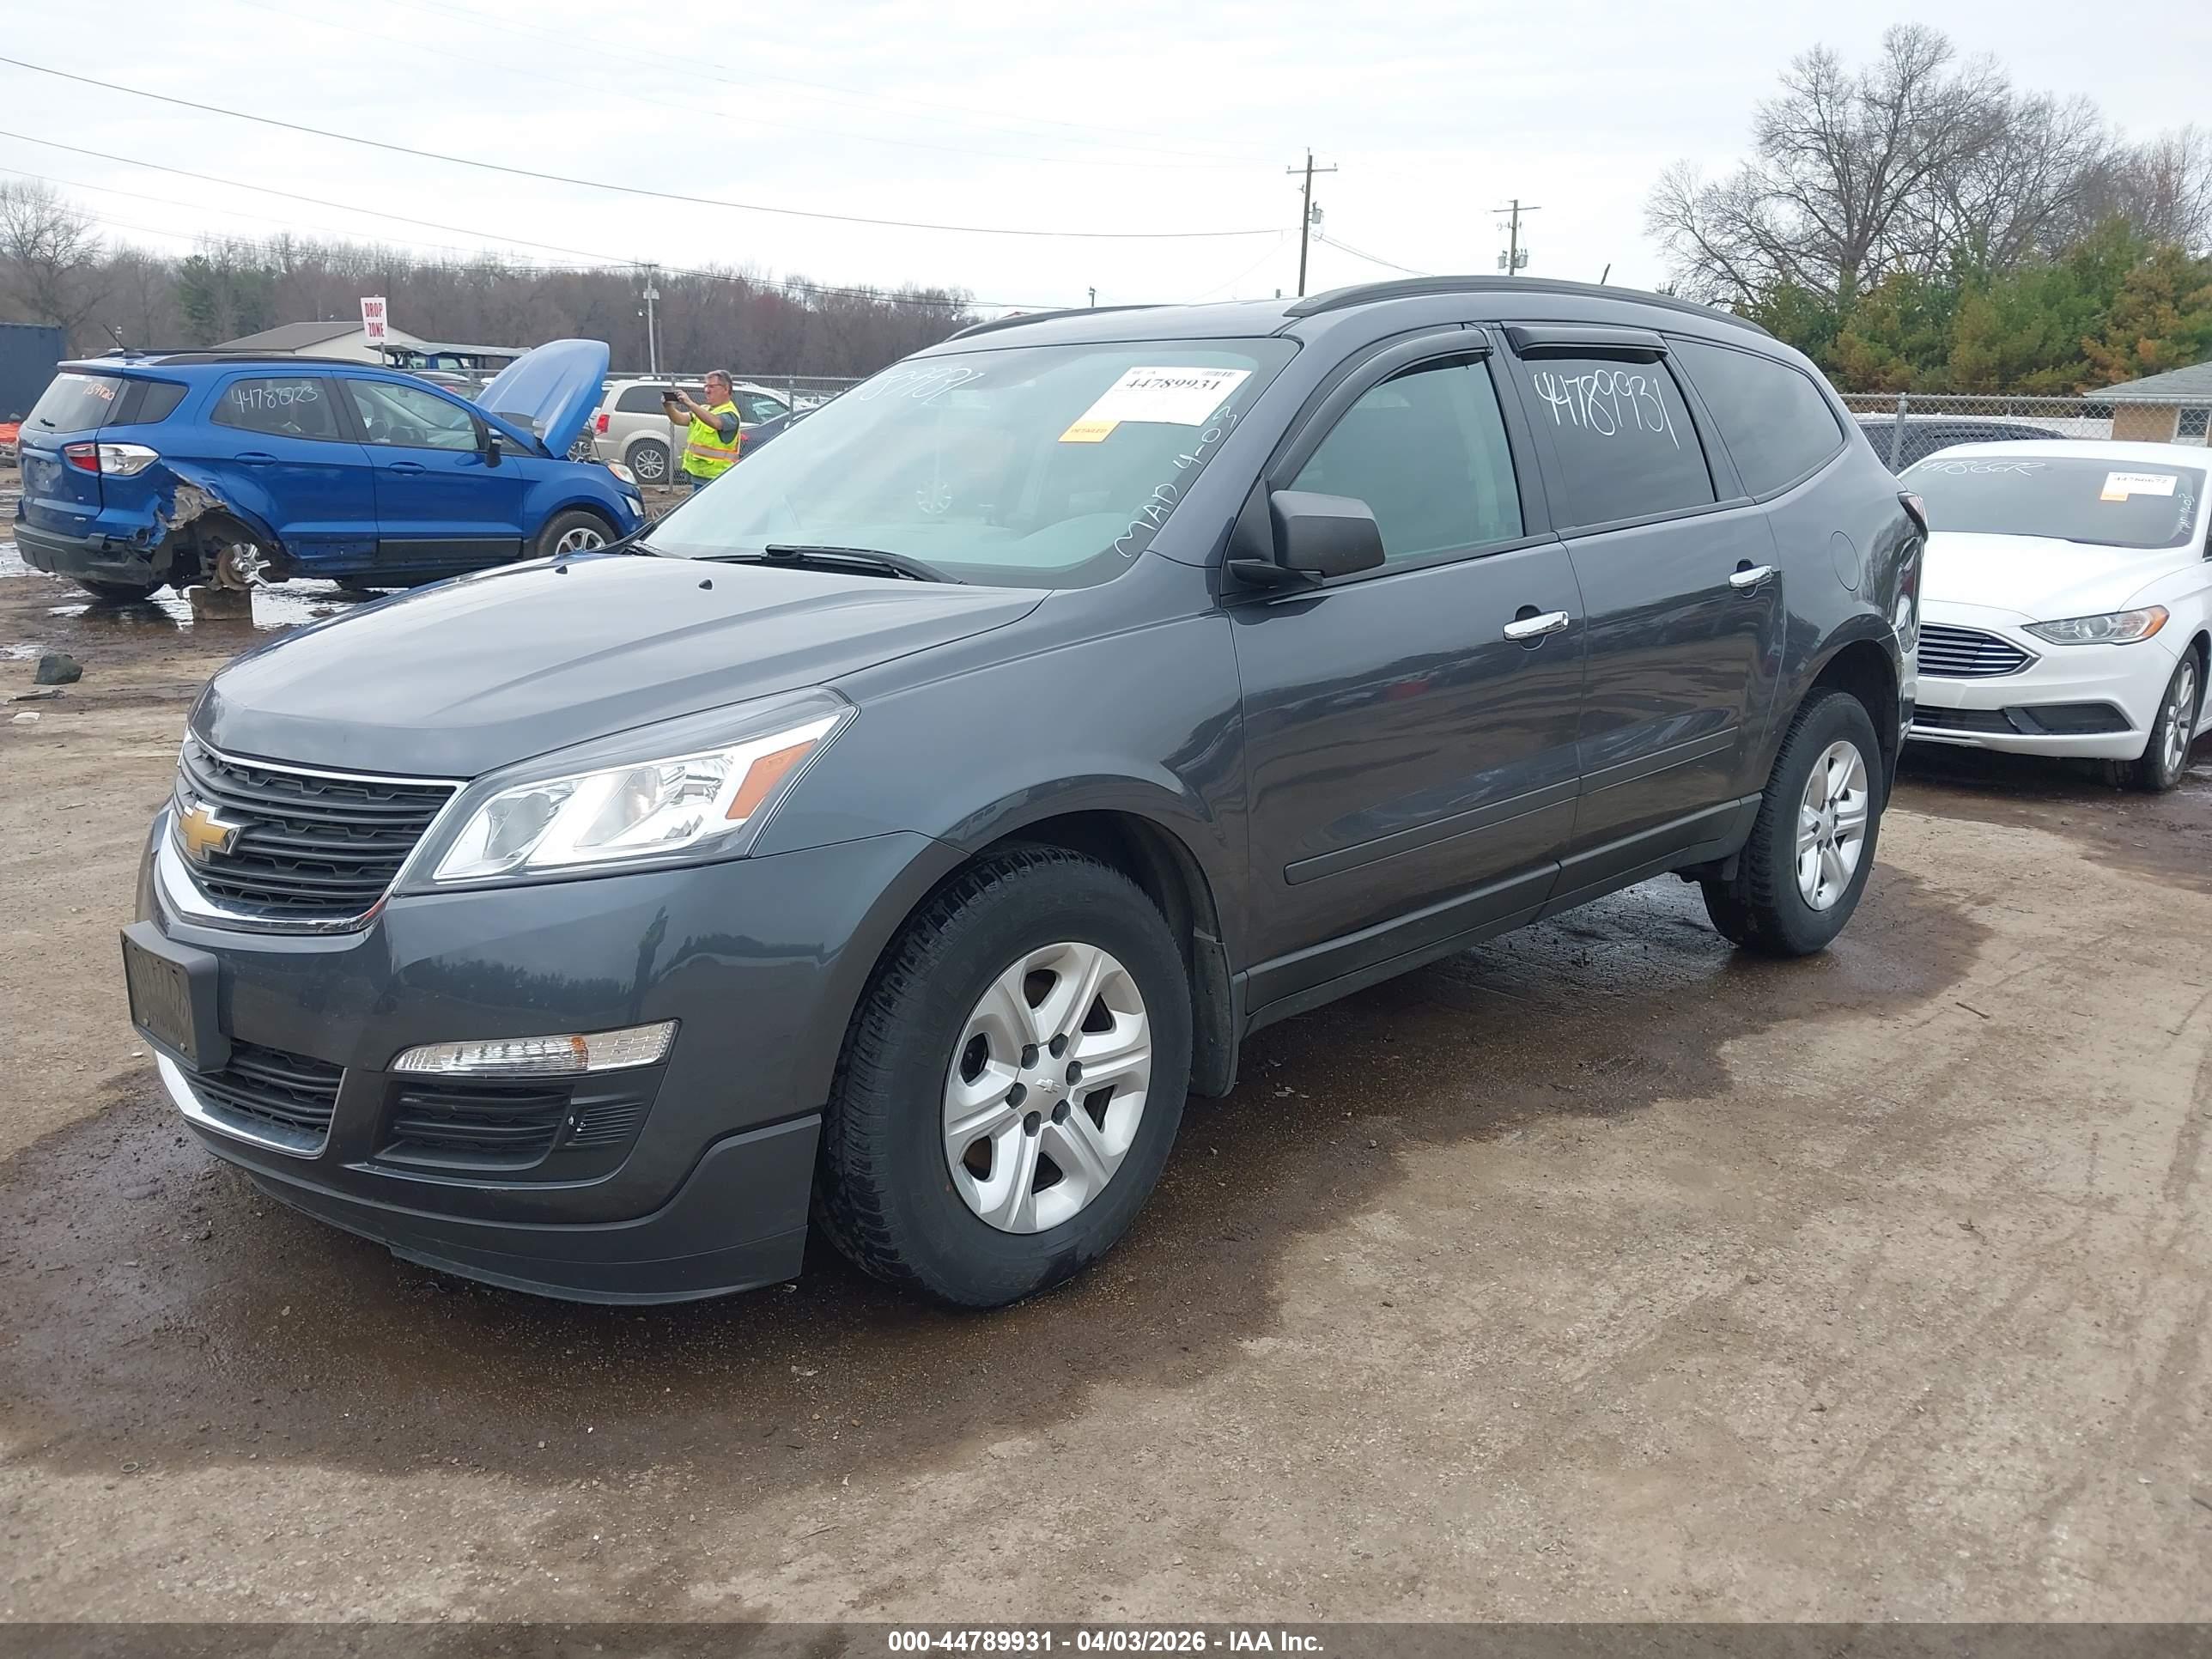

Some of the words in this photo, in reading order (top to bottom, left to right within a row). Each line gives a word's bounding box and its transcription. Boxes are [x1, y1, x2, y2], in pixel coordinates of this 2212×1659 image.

[364, 302, 384, 318] DROP
[368, 322, 385, 337] ZONE
[1126, 378, 1221, 391] 44789931
[1534, 369, 1680, 450] 44789931
[1114, 483, 1178, 558] MAD
[1173, 405, 1237, 469] 4-03
